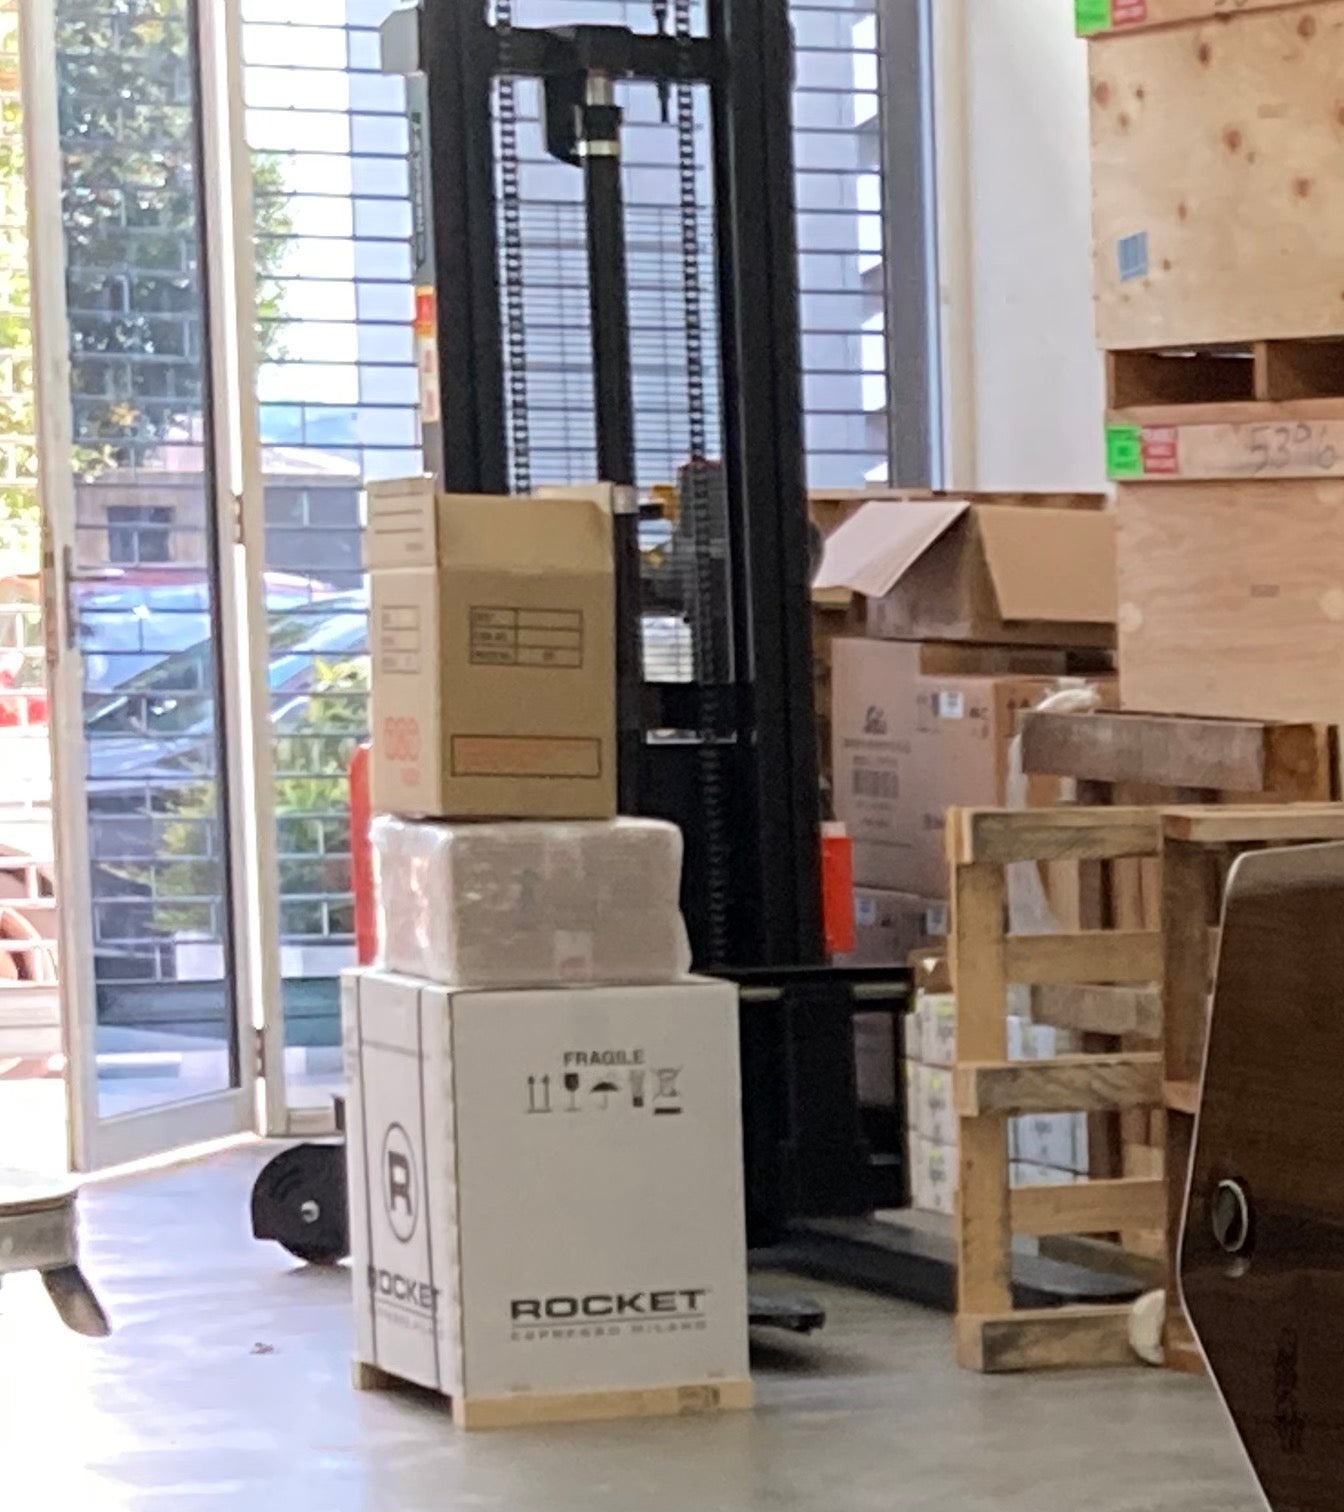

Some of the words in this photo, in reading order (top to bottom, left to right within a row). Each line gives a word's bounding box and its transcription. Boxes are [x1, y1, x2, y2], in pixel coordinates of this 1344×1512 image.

[563, 1049, 646, 1066] FRAGILE
[388, 1150, 412, 1216] R
[511, 1288, 706, 1320] ROCKET
